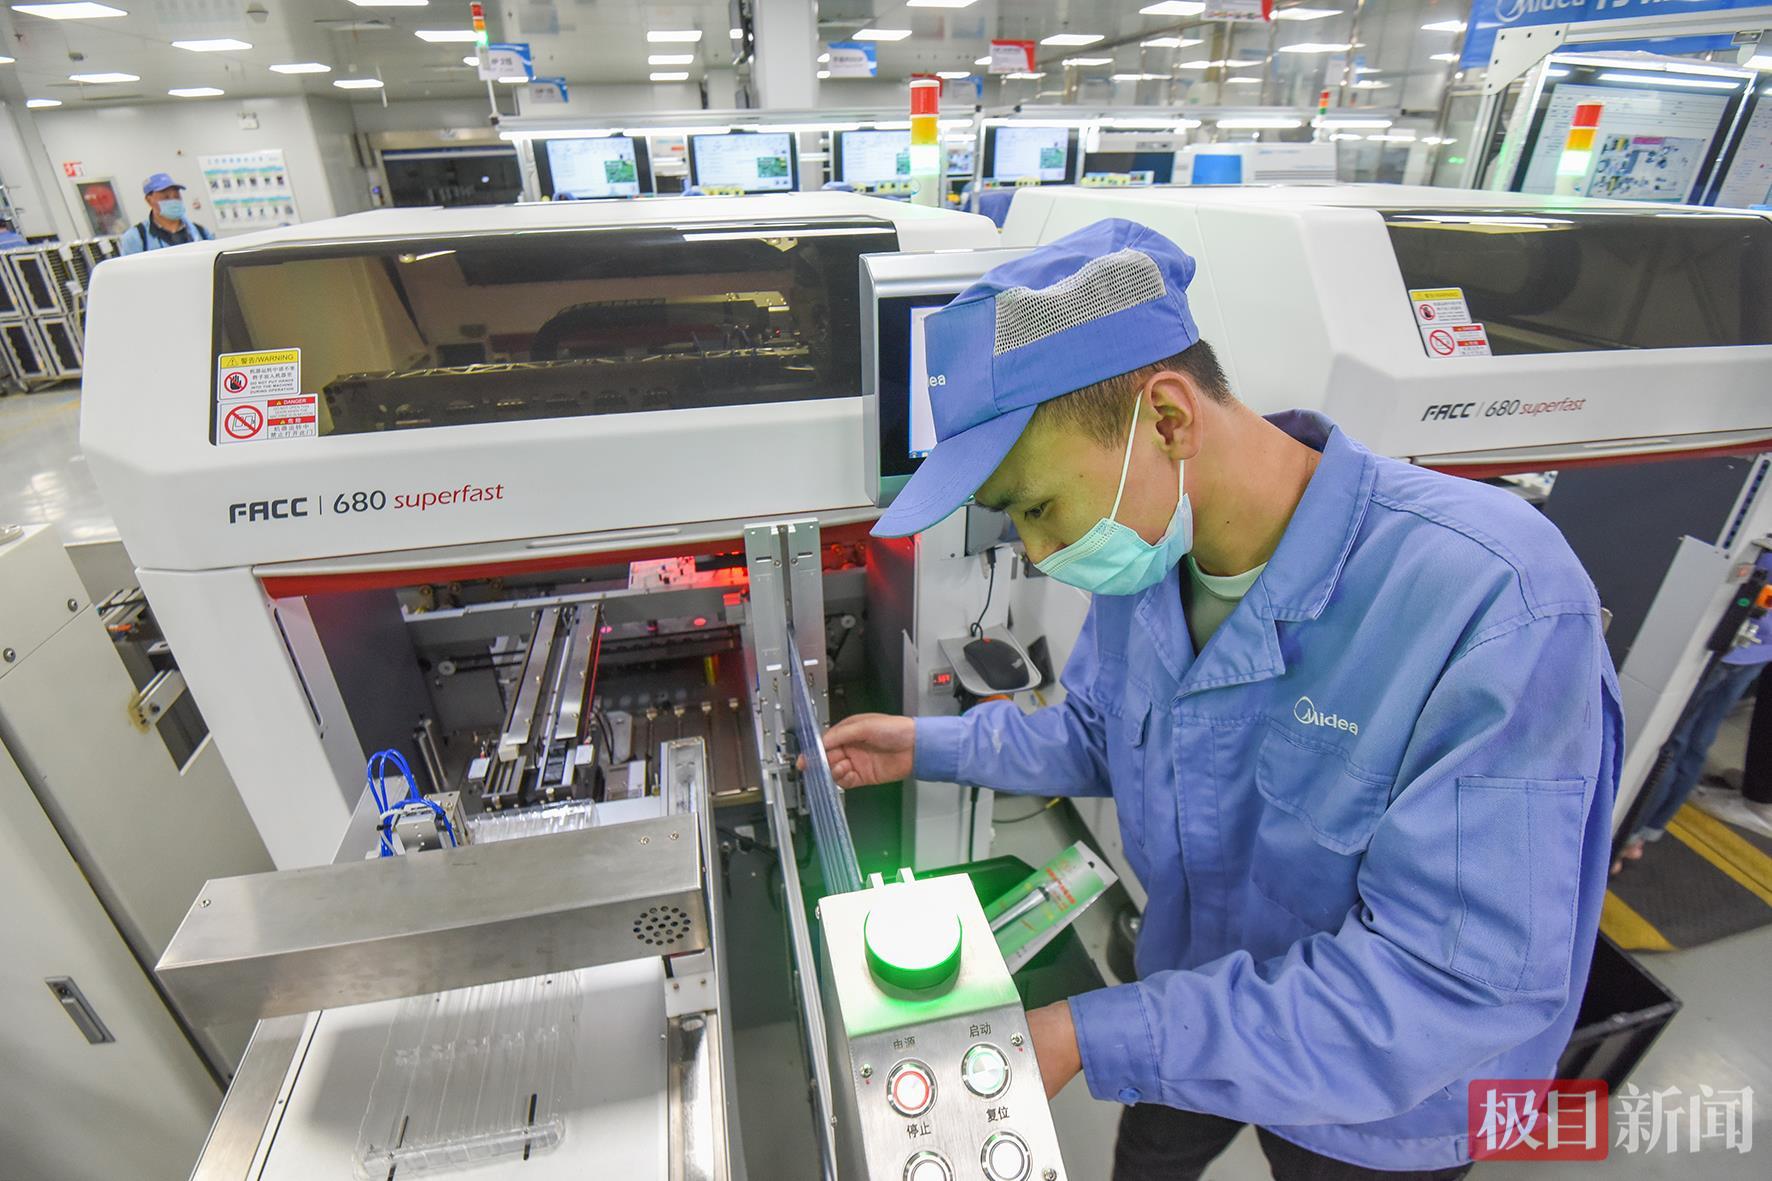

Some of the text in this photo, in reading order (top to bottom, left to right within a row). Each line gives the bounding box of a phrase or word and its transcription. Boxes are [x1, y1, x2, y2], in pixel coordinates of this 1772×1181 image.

[1421, 397, 1587, 421] FACC 680 superfast
[229, 484, 504, 524] FACC 680 superfast
[1293, 696, 1359, 736] Midea
[969, 1022, 992, 1038] 启动
[893, 1036, 916, 1050] 电源
[985, 1106, 1010, 1123] 复位
[906, 1121, 931, 1139] 停止
